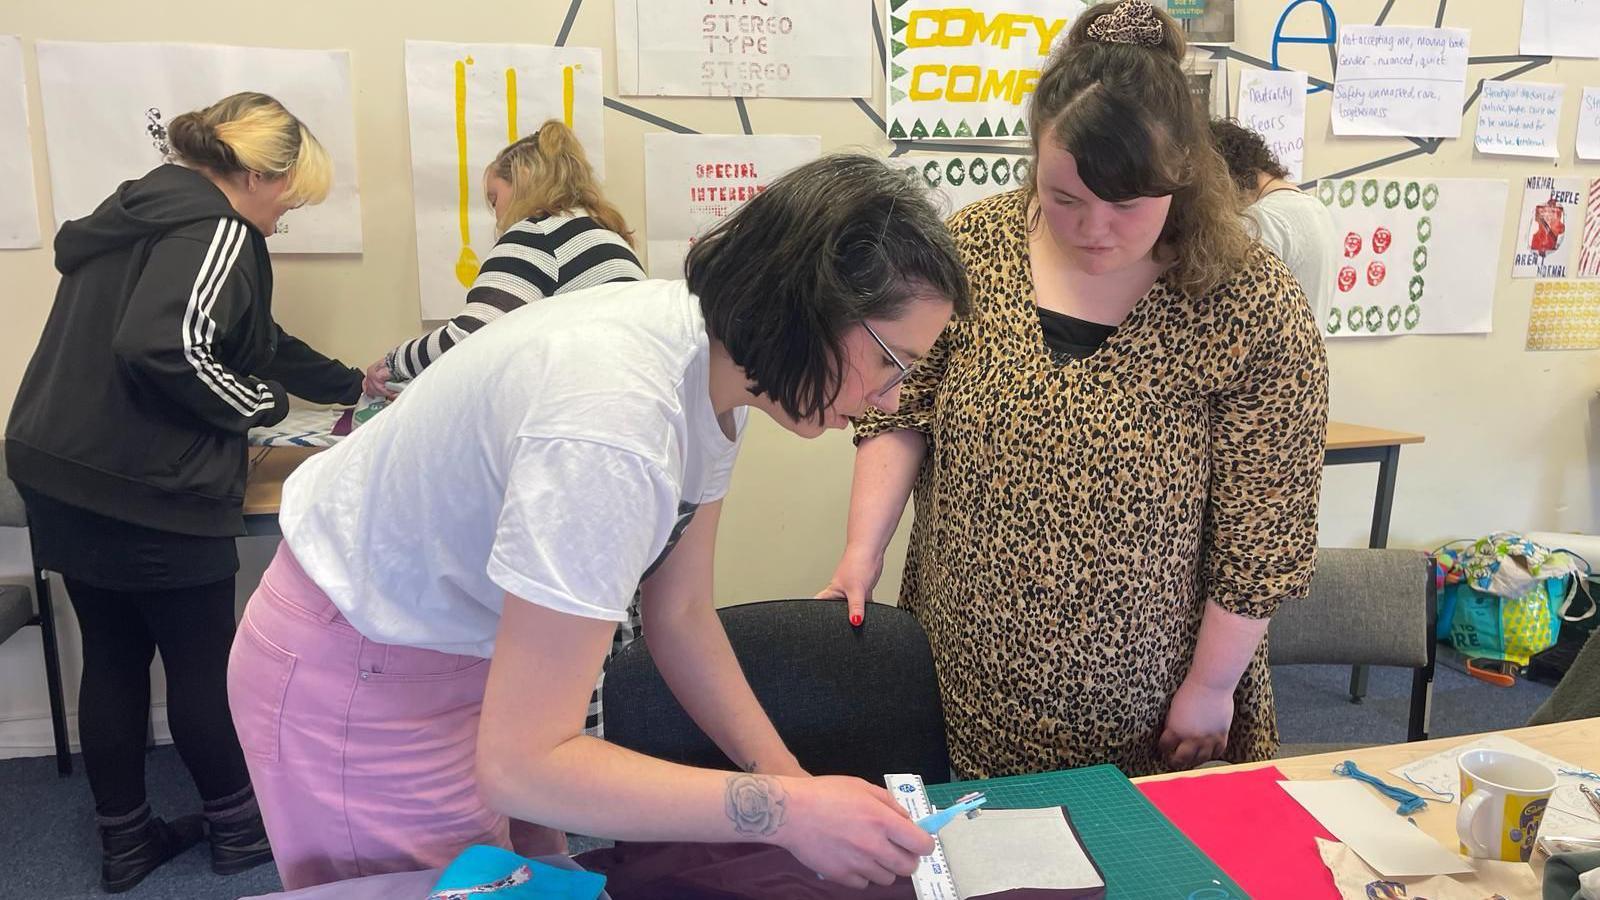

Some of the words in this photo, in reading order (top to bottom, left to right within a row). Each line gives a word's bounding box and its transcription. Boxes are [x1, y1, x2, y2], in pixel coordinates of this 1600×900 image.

[703, 14, 793, 34] STEREO
[906, 8, 1067, 56] COMFY
[702, 35, 768, 54] TYPE
[701, 61, 790, 80] STEREO
[1420, 56, 1448, 68] quiet
[1335, 84, 1366, 105] Safety
[696, 163, 757, 178] SPECIAL
[1526, 176, 1555, 189] NORMAL
[1550, 190, 1580, 204] PEOPLE
[1536, 264, 1566, 278] NORMAL
